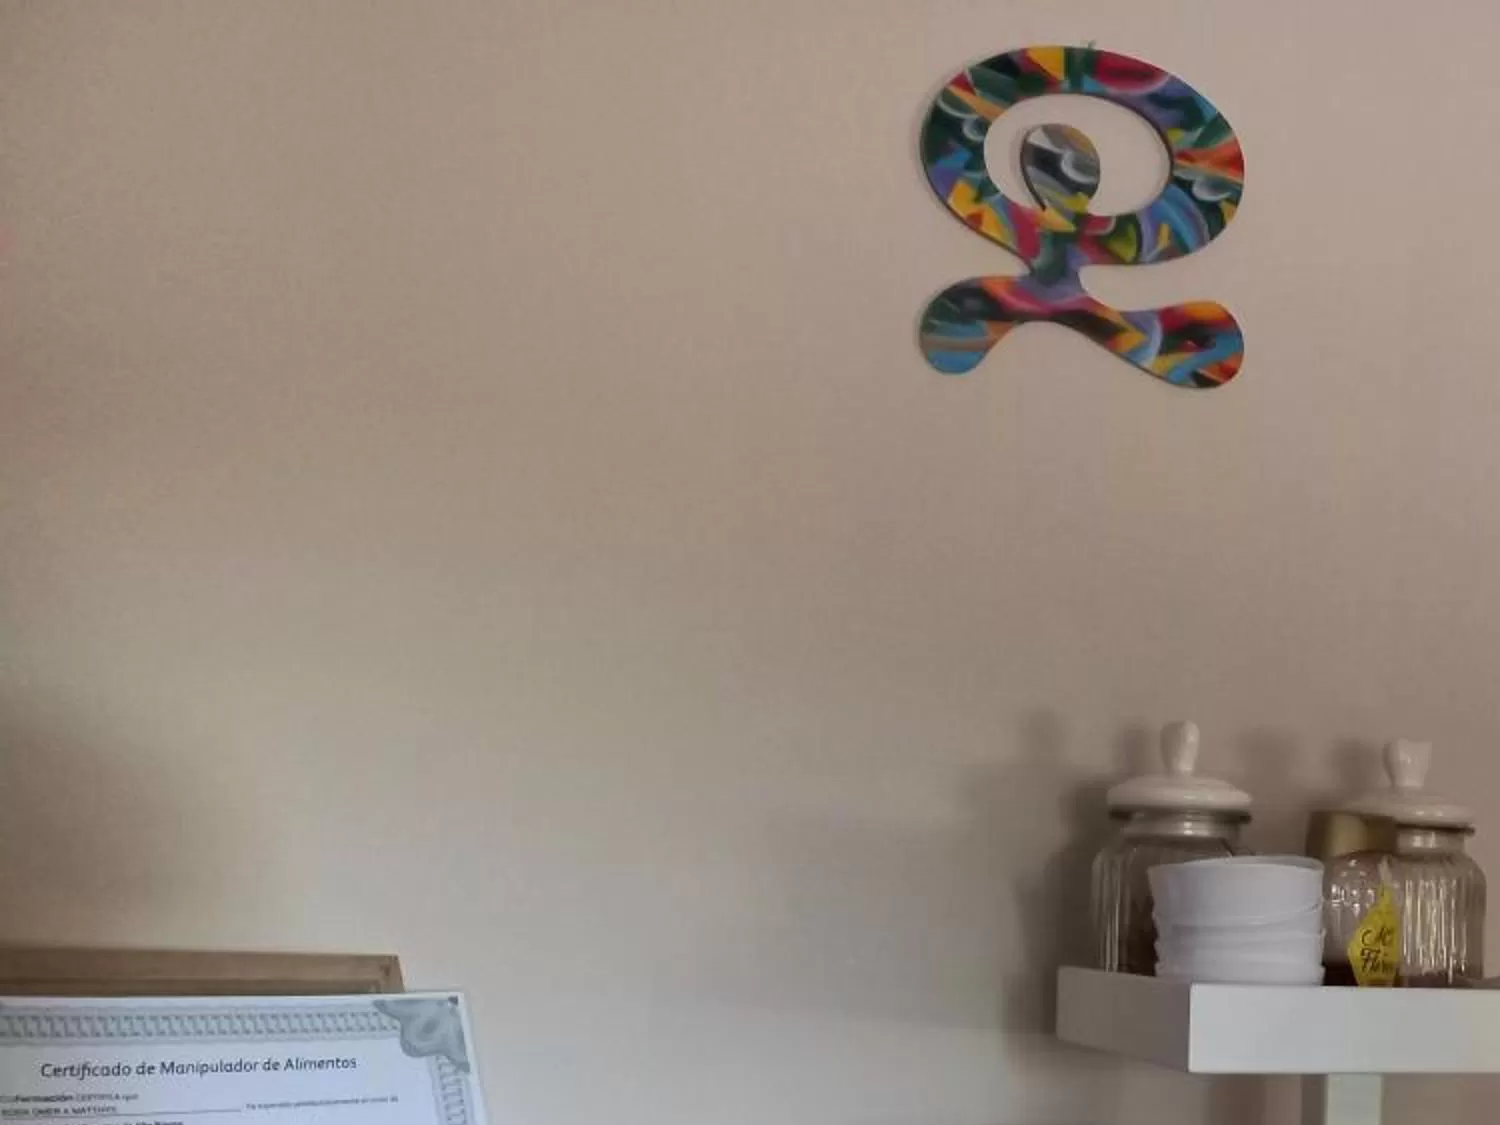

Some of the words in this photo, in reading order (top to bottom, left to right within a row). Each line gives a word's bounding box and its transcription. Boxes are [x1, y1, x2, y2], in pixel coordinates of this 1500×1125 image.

[40, 1061, 132, 1081] Certificado
[136, 1061, 157, 1076] de
[159, 1058, 258, 1077] Manipulador
[261, 1058, 281, 1072] de
[283, 1056, 358, 1071] Alimentos
